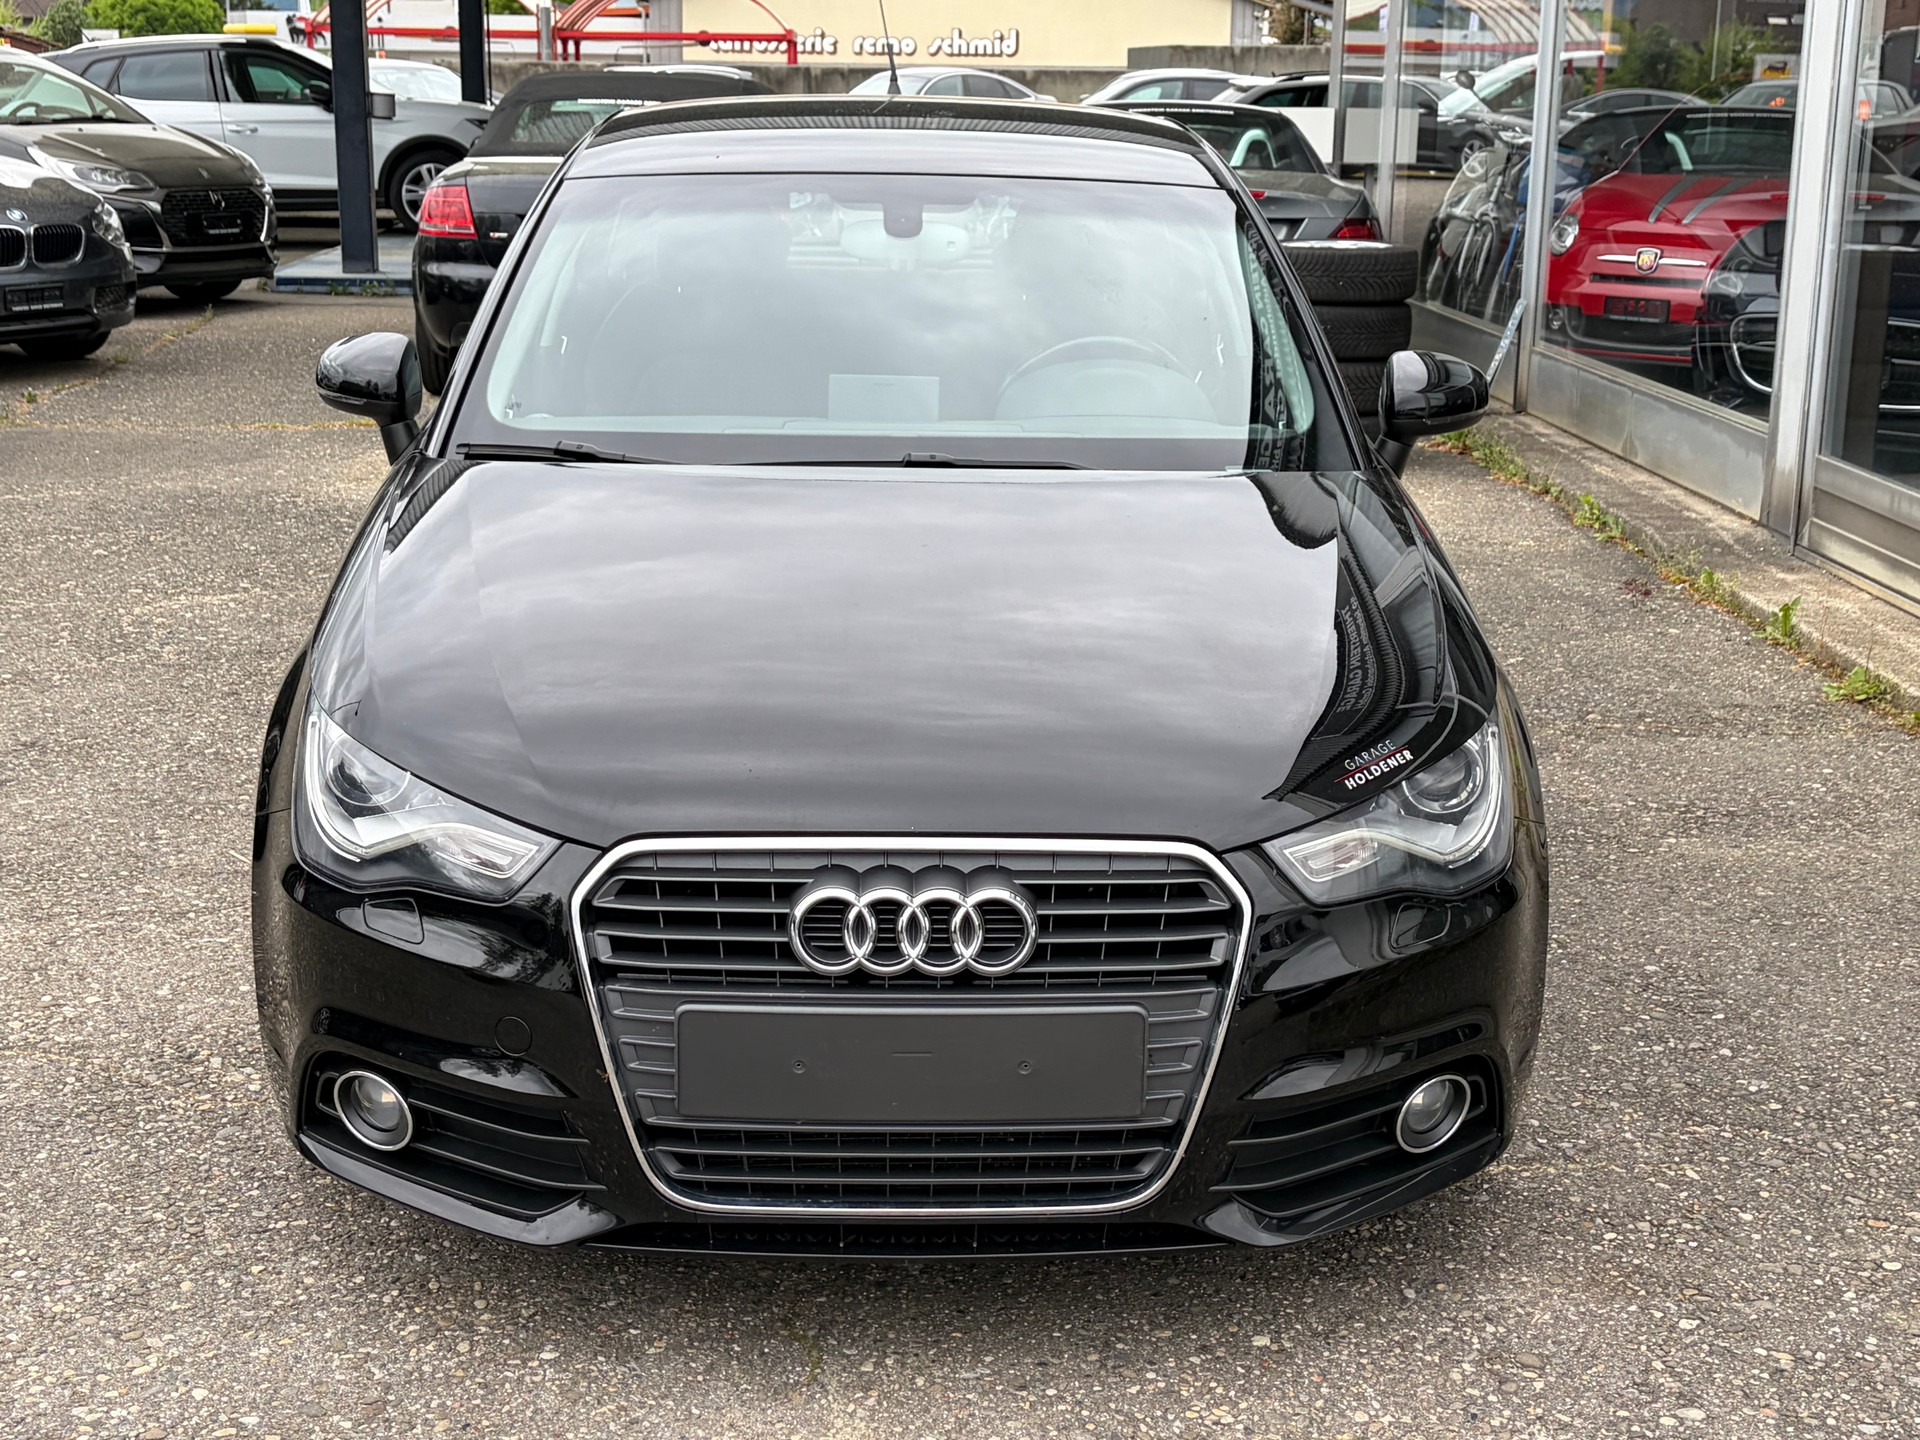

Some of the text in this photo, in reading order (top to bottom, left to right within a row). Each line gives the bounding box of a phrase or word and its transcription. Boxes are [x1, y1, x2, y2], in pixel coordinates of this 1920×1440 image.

[852, 36, 918, 56] remo
[927, 27, 1019, 57] schmid
[1344, 740, 1396, 770] GARAGE
[1344, 749, 1414, 790] HOLDENER
